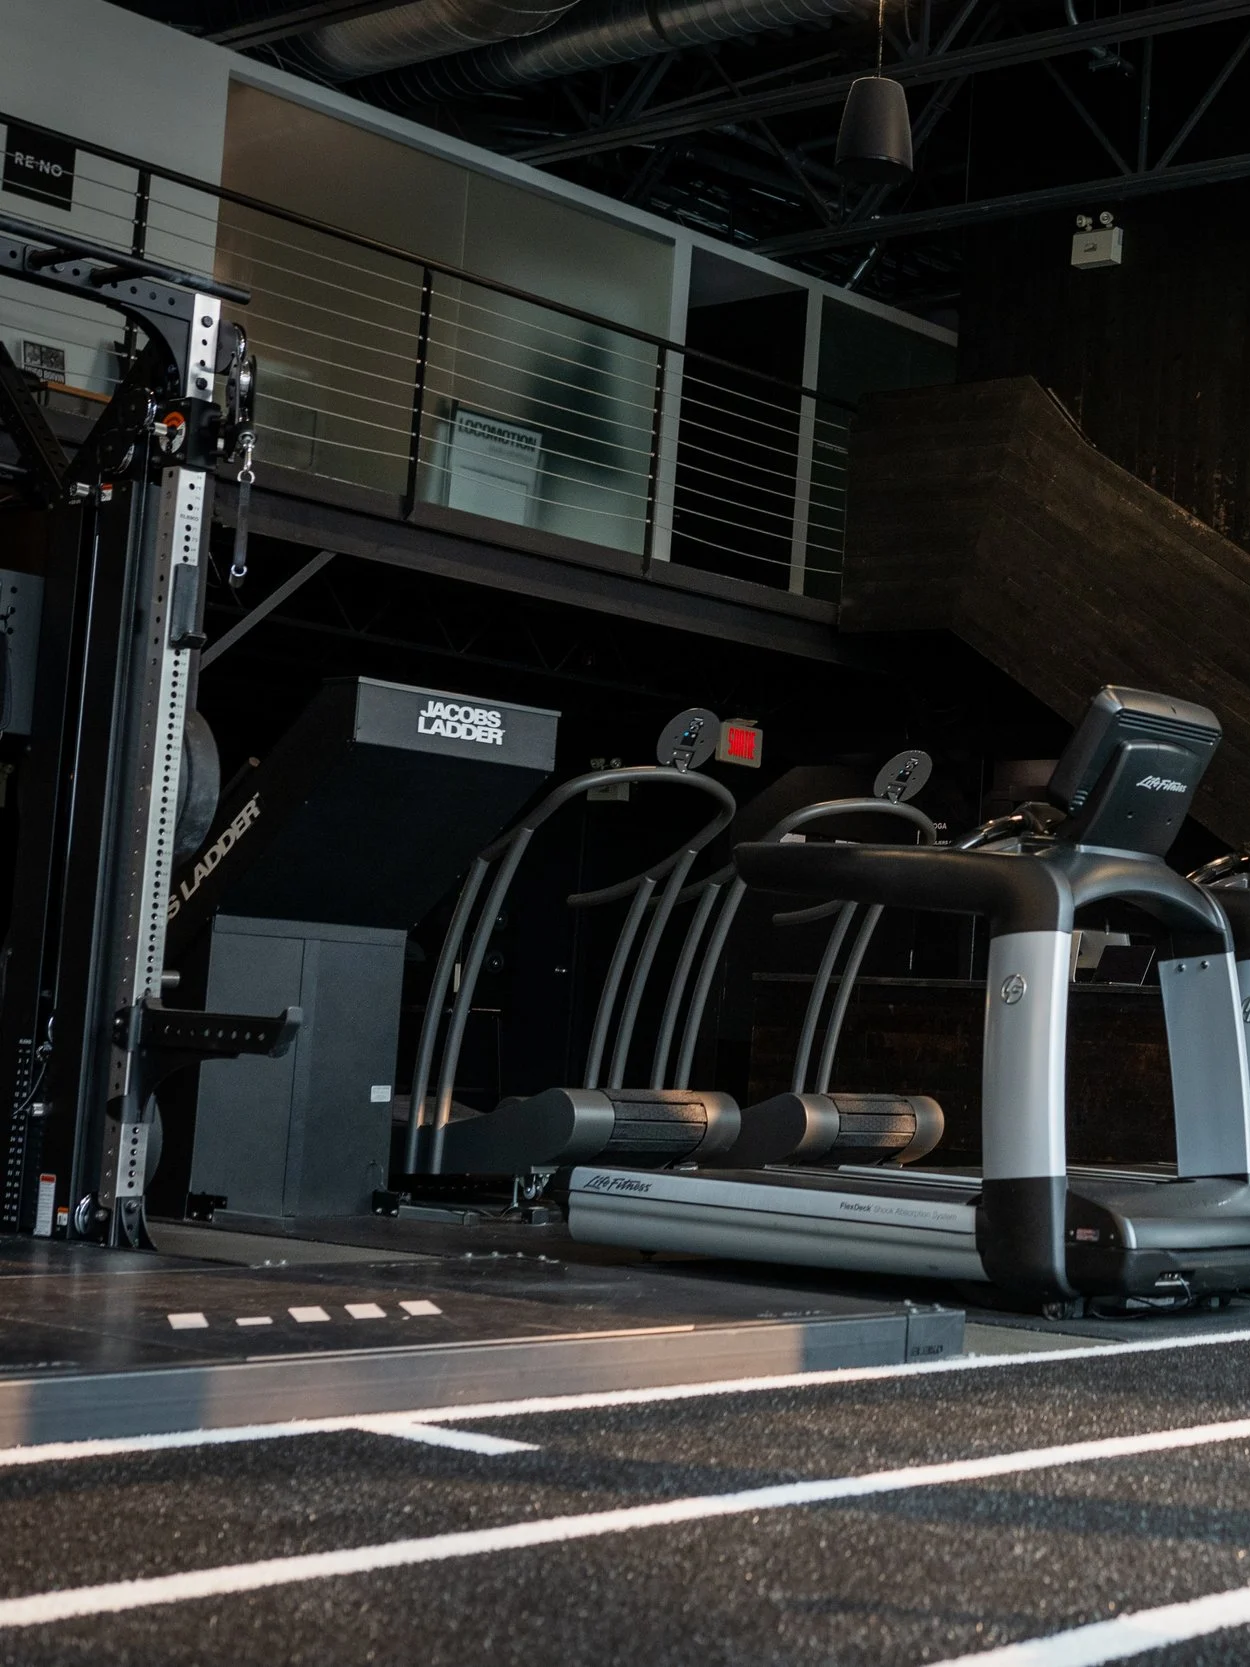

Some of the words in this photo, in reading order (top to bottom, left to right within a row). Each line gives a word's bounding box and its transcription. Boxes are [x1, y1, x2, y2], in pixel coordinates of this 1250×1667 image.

[457, 417, 537, 452] LOCOMOTION
[420, 700, 502, 728] JACOBS
[417, 716, 504, 745] LADDER
[727, 726, 756, 761] SORTIE
[1135, 775, 1161, 790] Life
[1155, 779, 1188, 793] Fitness
[179, 798, 261, 901] LADDER
[583, 1175, 610, 1190] Life
[607, 1178, 653, 1193] Fitness
